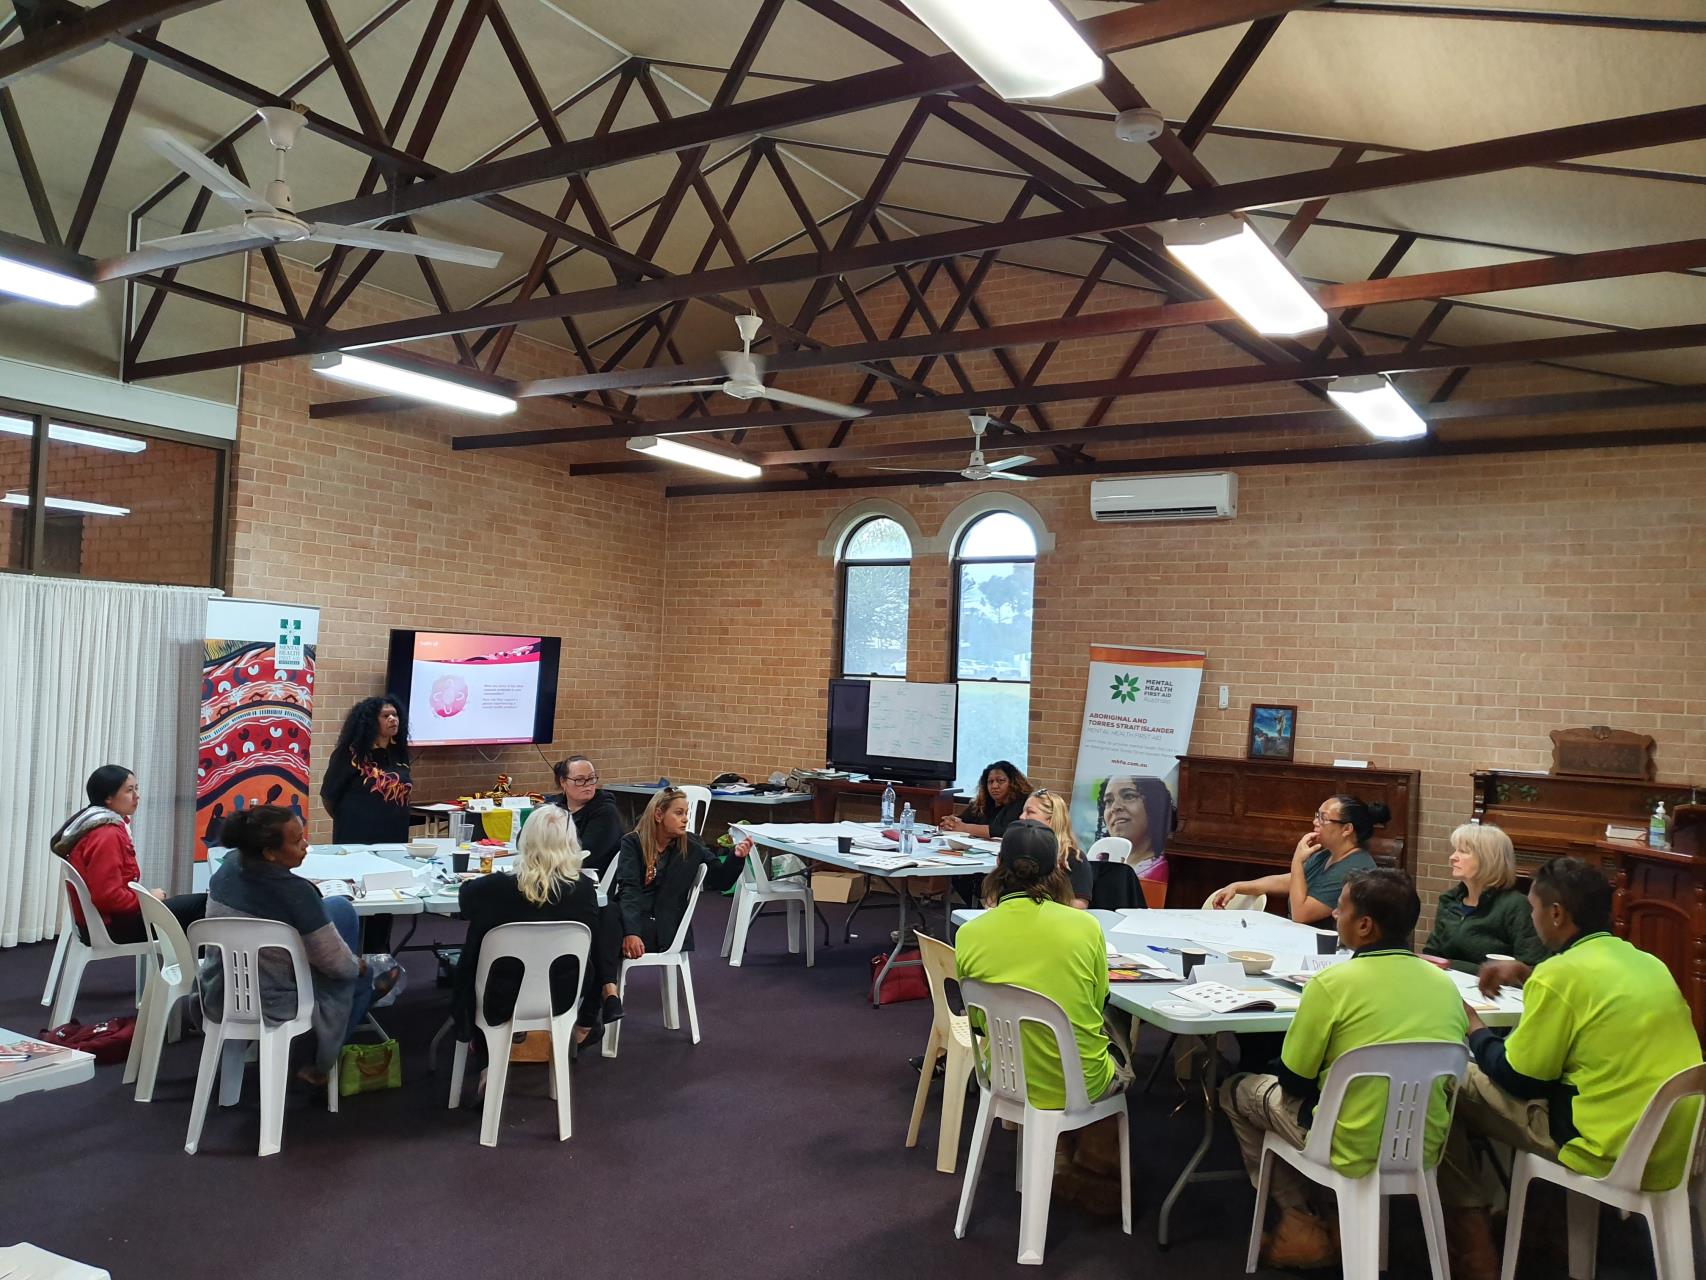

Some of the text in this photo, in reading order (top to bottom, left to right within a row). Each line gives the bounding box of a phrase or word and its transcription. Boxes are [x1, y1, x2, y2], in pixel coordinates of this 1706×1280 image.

[1089, 712, 1131, 722] ABORIGINAL
[1088, 720, 1174, 734] TORRES STRAIT ISLANDER
[1111, 760, 1147, 768] mhfa.com.au
